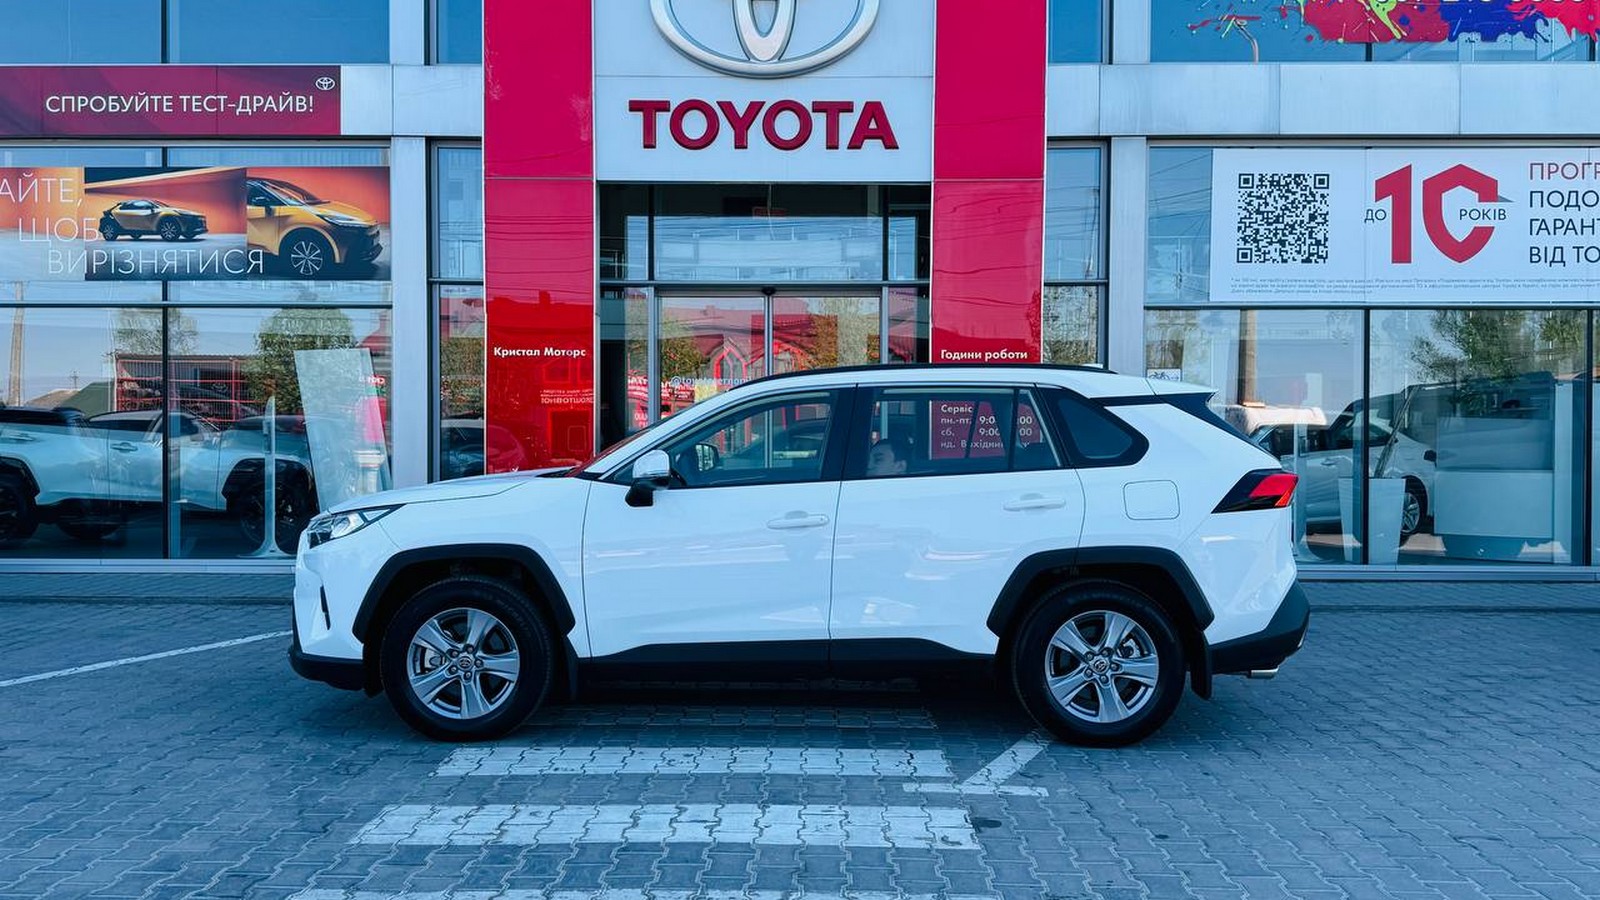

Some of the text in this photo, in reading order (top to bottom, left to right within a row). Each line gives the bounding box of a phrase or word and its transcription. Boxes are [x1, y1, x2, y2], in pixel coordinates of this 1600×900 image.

[45, 92, 314, 115] СПРОБУЙТЕ ТЕСТ-ДРАЙВ!
[629, 99, 899, 150] TOYOTA
[0, 172, 82, 208] АЙТЕ,
[1529, 190, 1600, 212] ПОДО
[1364, 208, 1387, 224] ДО
[1459, 208, 1507, 221] РОКІВ
[18, 217, 100, 248] ЩОБ
[48, 249, 264, 275] ВИРІЗНЯТИСЯ
[1529, 245, 1600, 268] ВІД ТО
[493, 346, 587, 359] Кристал Моторс
[941, 349, 1028, 362] Години роботи
[941, 404, 973, 415] Сервіс
